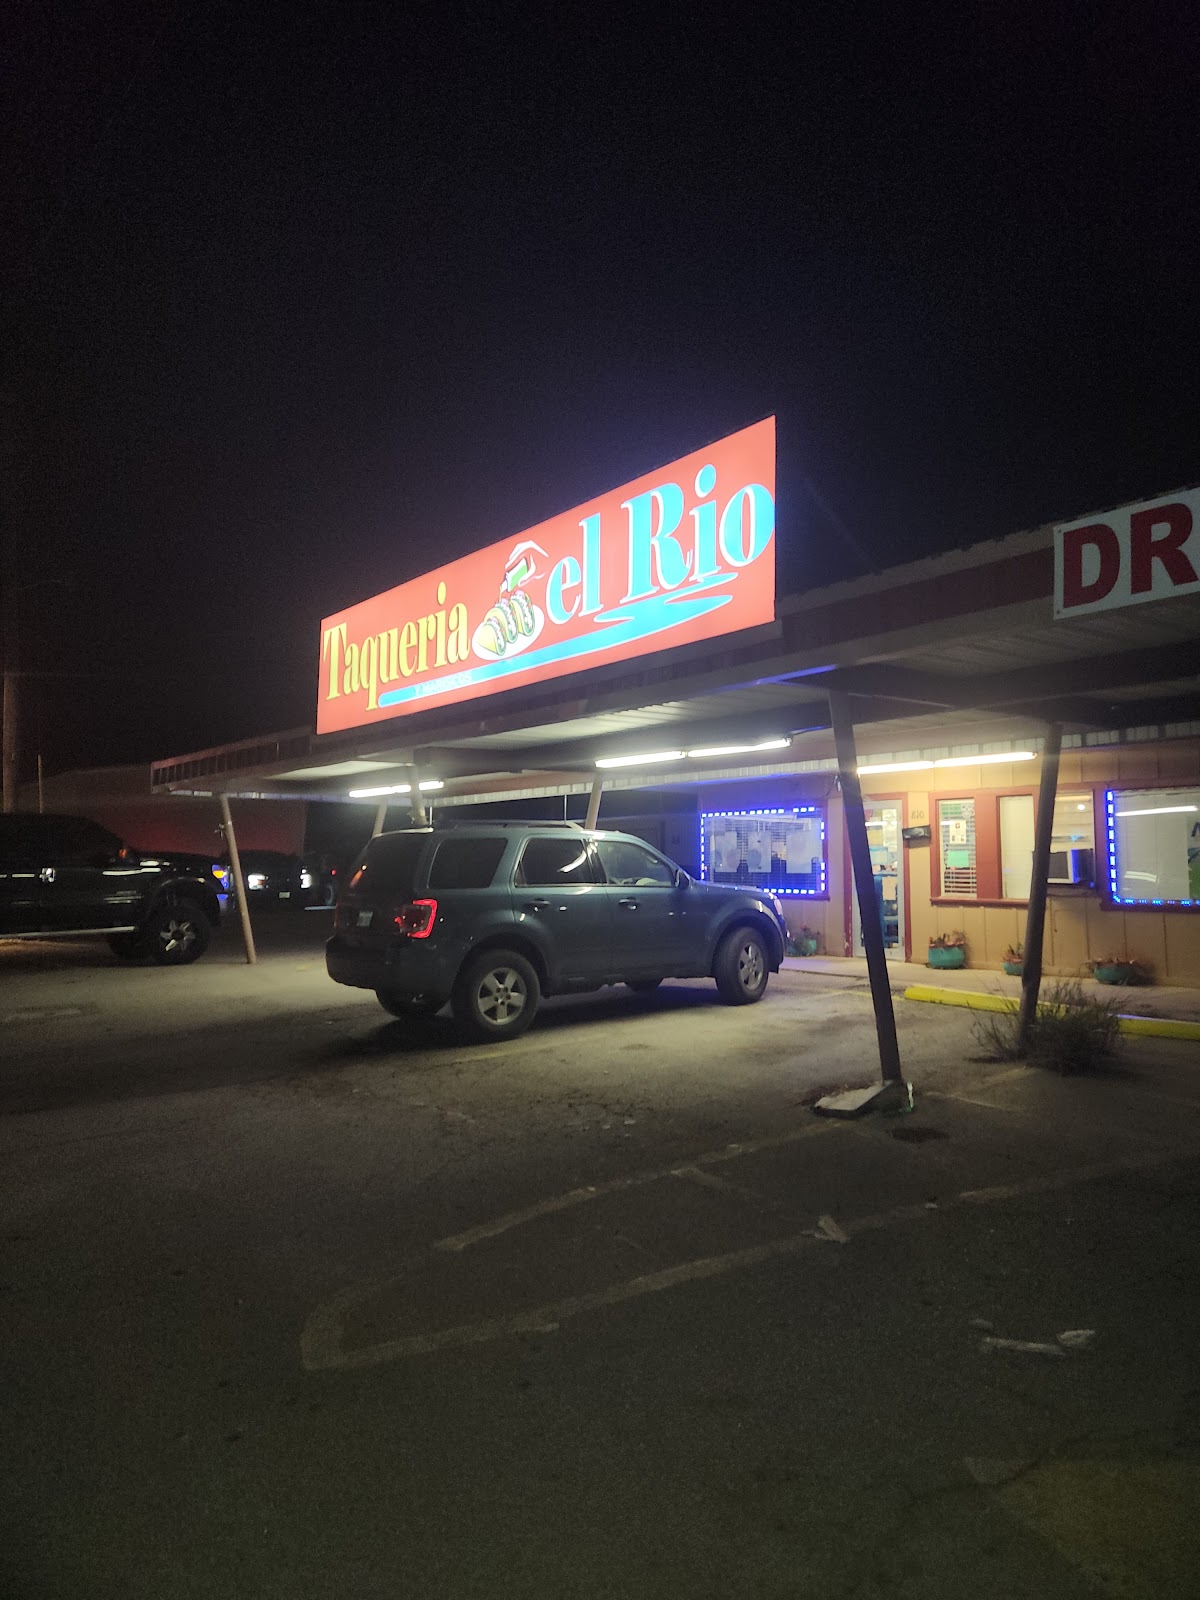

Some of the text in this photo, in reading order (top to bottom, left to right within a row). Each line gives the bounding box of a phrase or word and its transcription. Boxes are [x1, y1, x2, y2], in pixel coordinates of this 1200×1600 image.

[322, 464, 775, 711] Taqueria el Rio
[1063, 502, 1200, 609] DR
